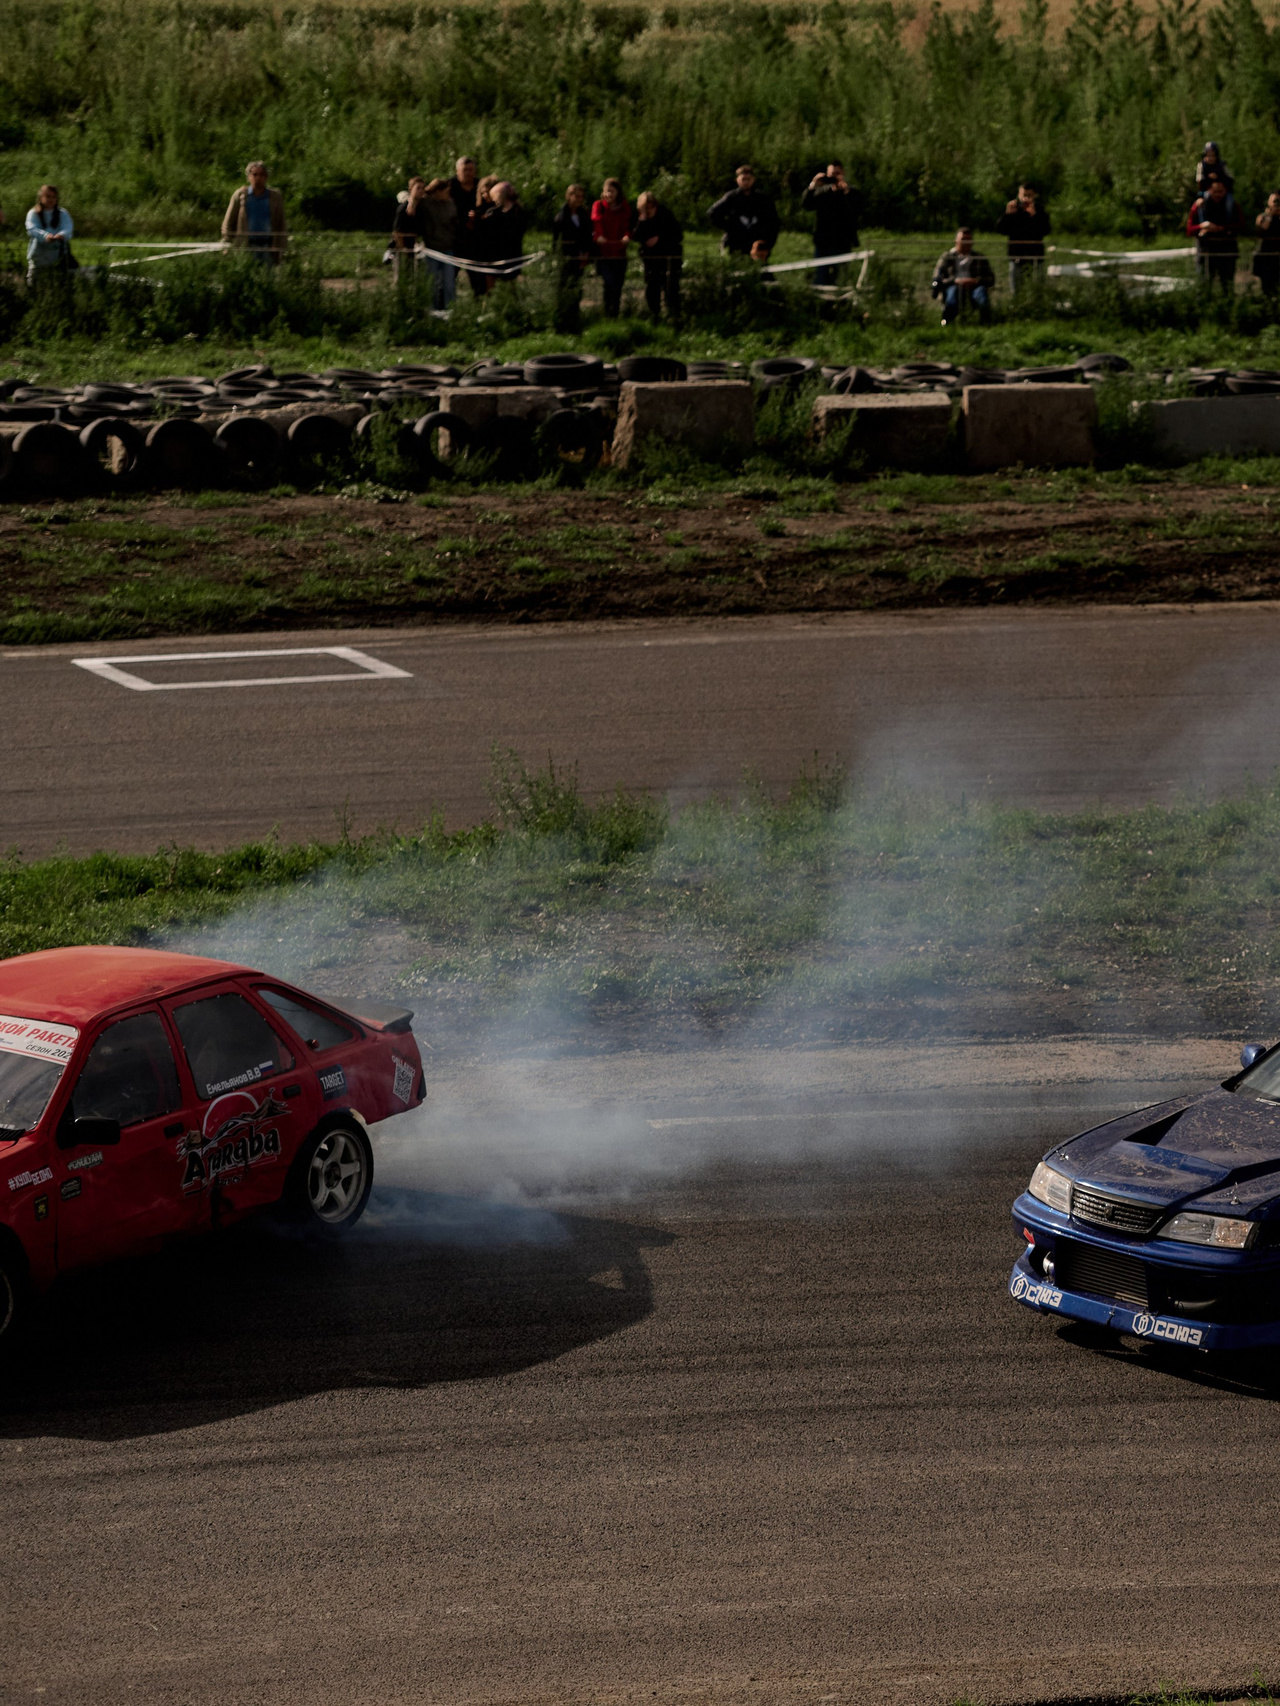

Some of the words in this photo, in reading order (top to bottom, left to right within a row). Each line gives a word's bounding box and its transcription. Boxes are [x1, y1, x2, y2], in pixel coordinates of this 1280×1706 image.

[0, 1021, 28, 1036] КОЙ
[26, 1044, 52, 1054] СЕЗОН
[51, 1048, 72, 1060] 202
[206, 1073, 249, 1095] Емельянов
[320, 1071, 345, 1090] TARGET
[1153, 1320, 1202, 1346] СОЮЗ
